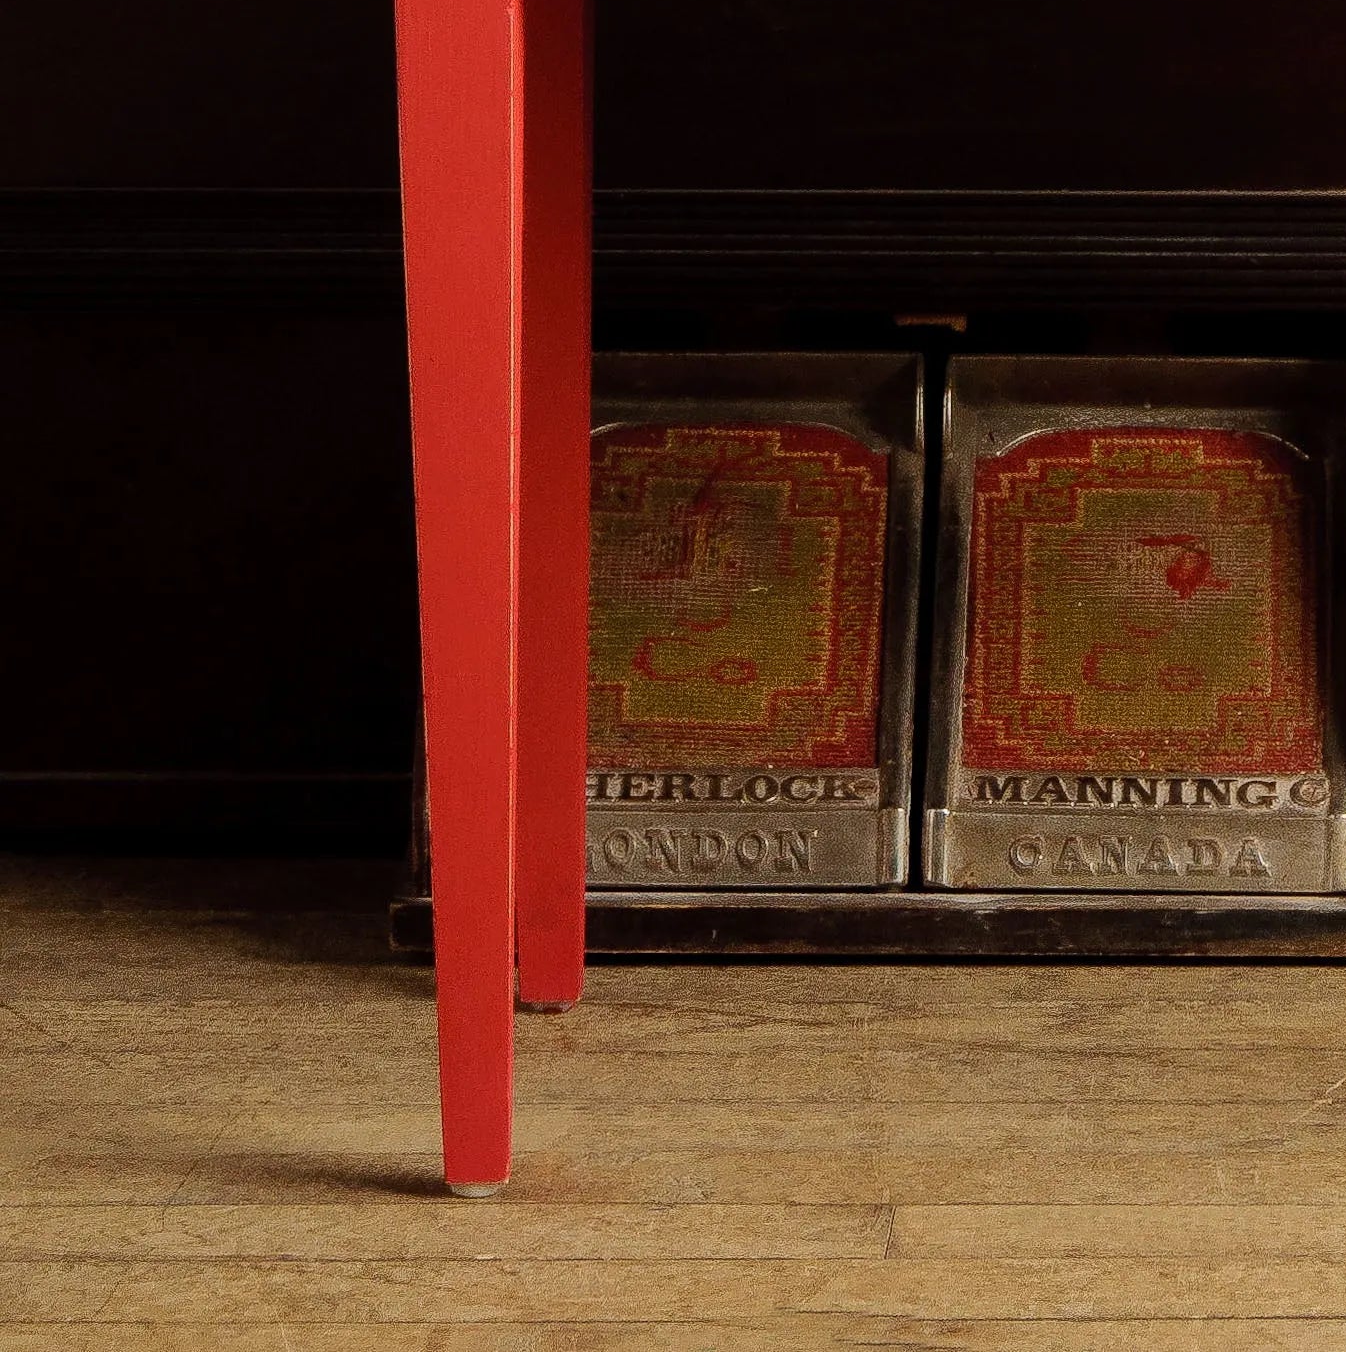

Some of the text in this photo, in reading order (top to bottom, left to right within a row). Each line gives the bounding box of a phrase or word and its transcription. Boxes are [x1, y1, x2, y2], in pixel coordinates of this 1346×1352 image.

[972, 775, 1279, 809] MANNING
[588, 825, 1272, 877] ONDON CANADA
